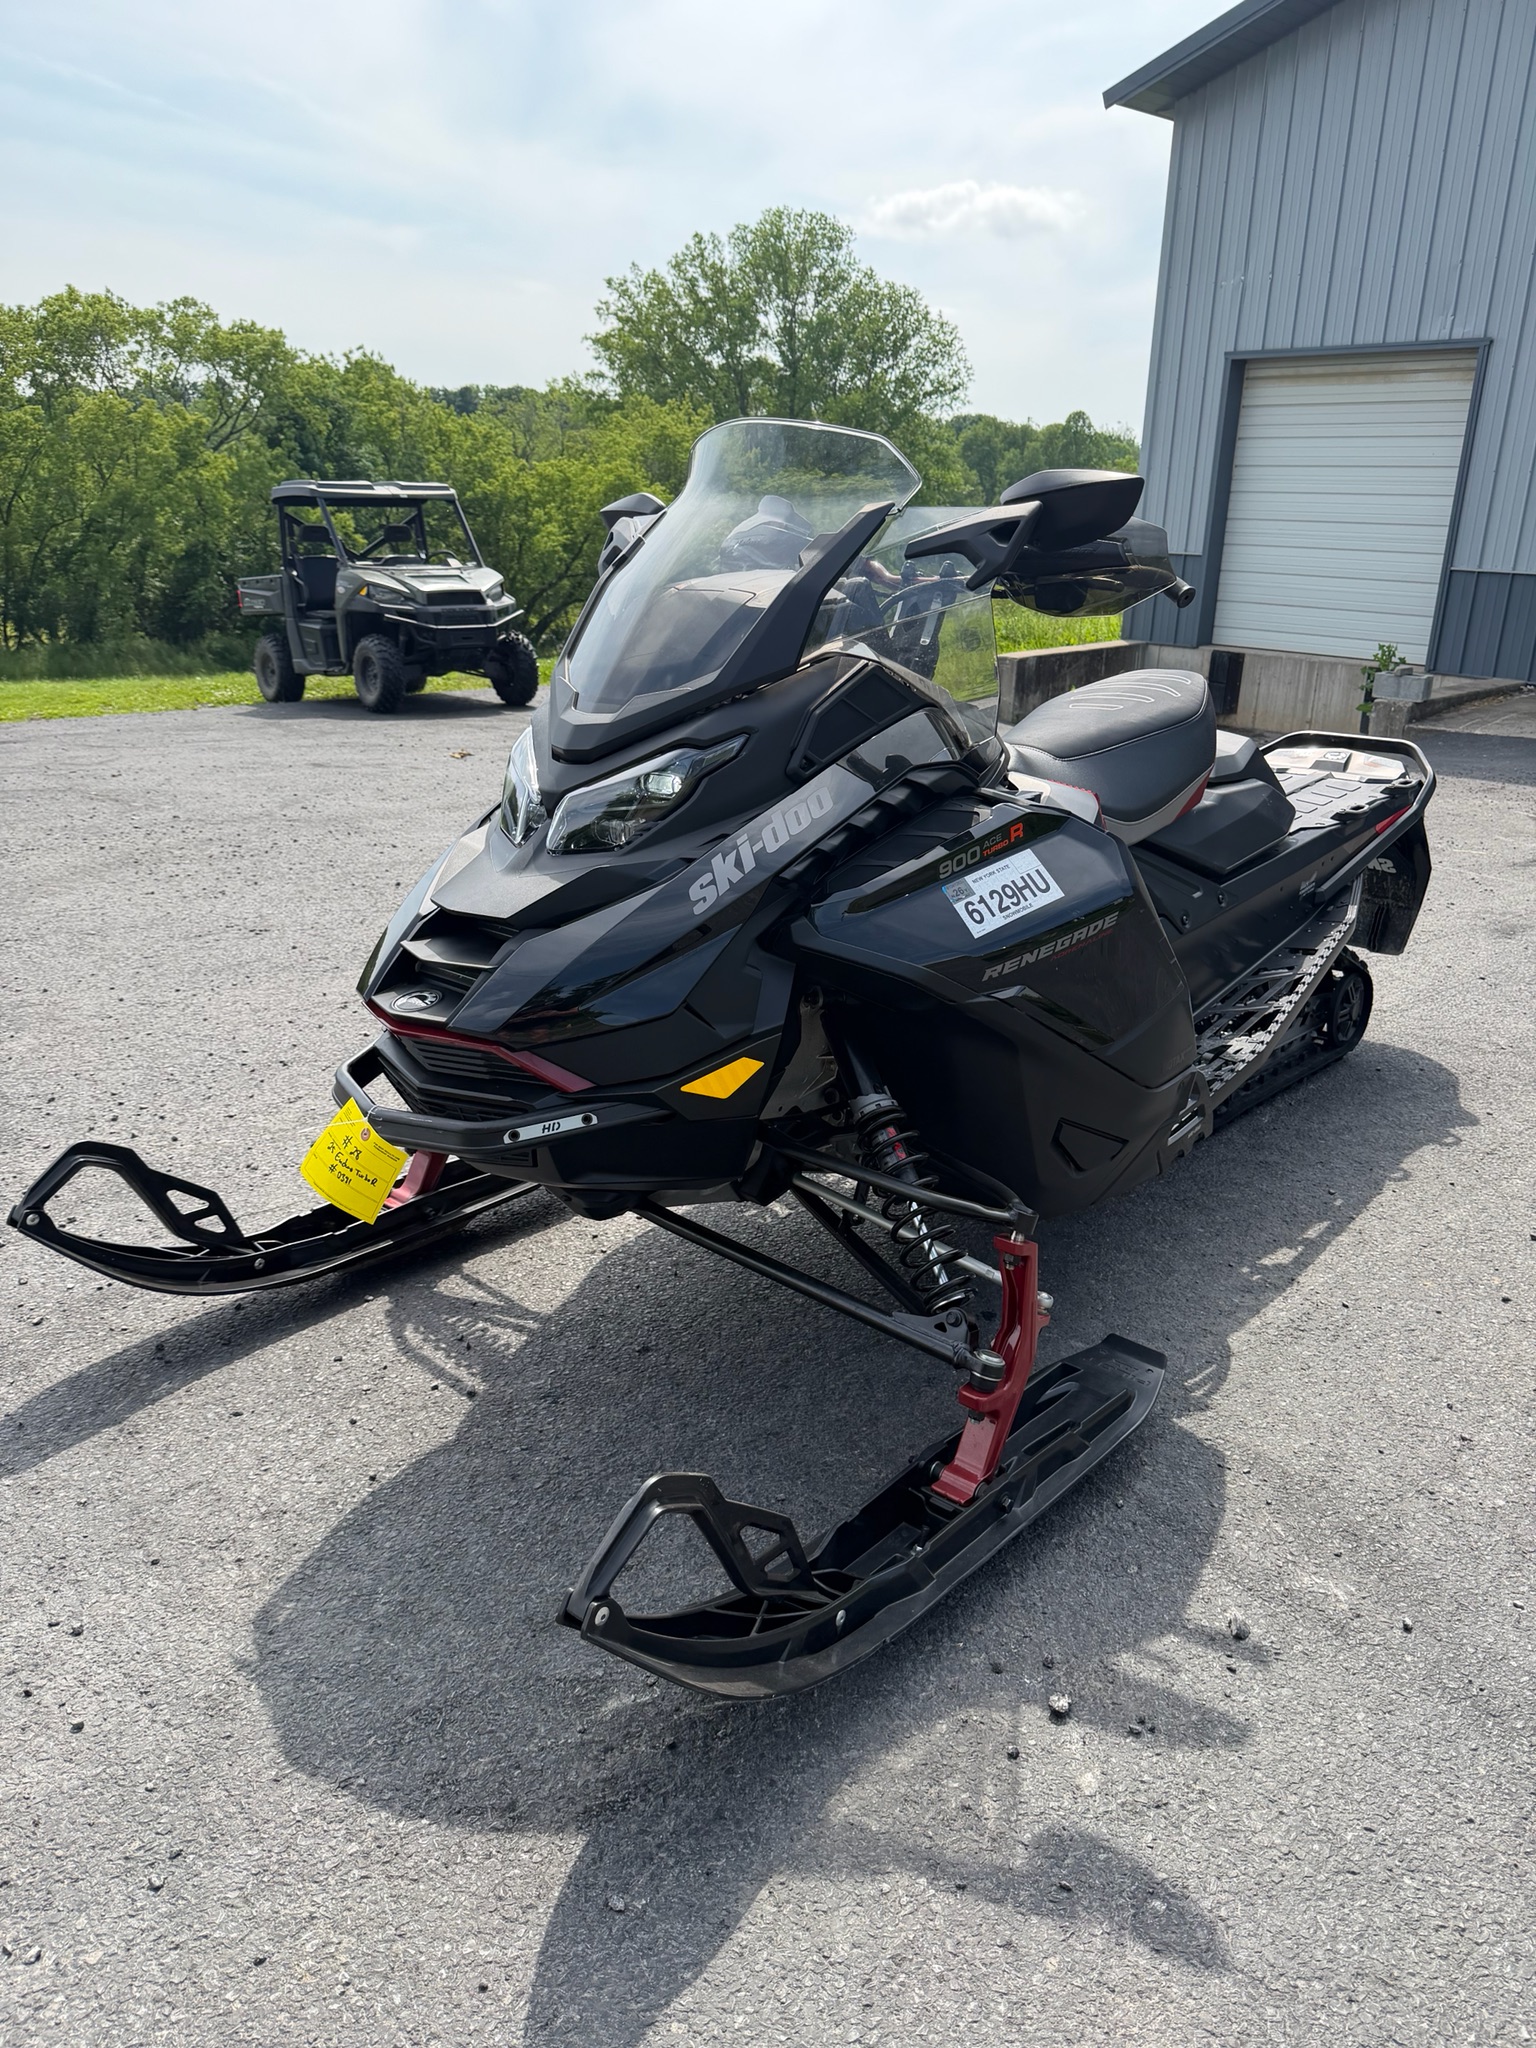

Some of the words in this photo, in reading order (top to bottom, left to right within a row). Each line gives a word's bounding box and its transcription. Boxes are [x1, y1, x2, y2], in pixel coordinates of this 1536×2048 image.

[688, 786, 834, 915] ski-doo
[939, 845, 981, 880] 900
[982, 833, 1002, 850] ACE
[982, 838, 1009, 857] TURBO
[1009, 822, 1024, 843] R
[972, 875, 984, 884] NEW
[983, 870, 997, 881] YORK
[995, 863, 1011, 874] STATE
[964, 868, 1051, 925] 6129HU
[1002, 902, 1034, 920] SNOWMOBILE
[981, 910, 1120, 982] RENEGADE
[541, 1121, 561, 1135] HD
